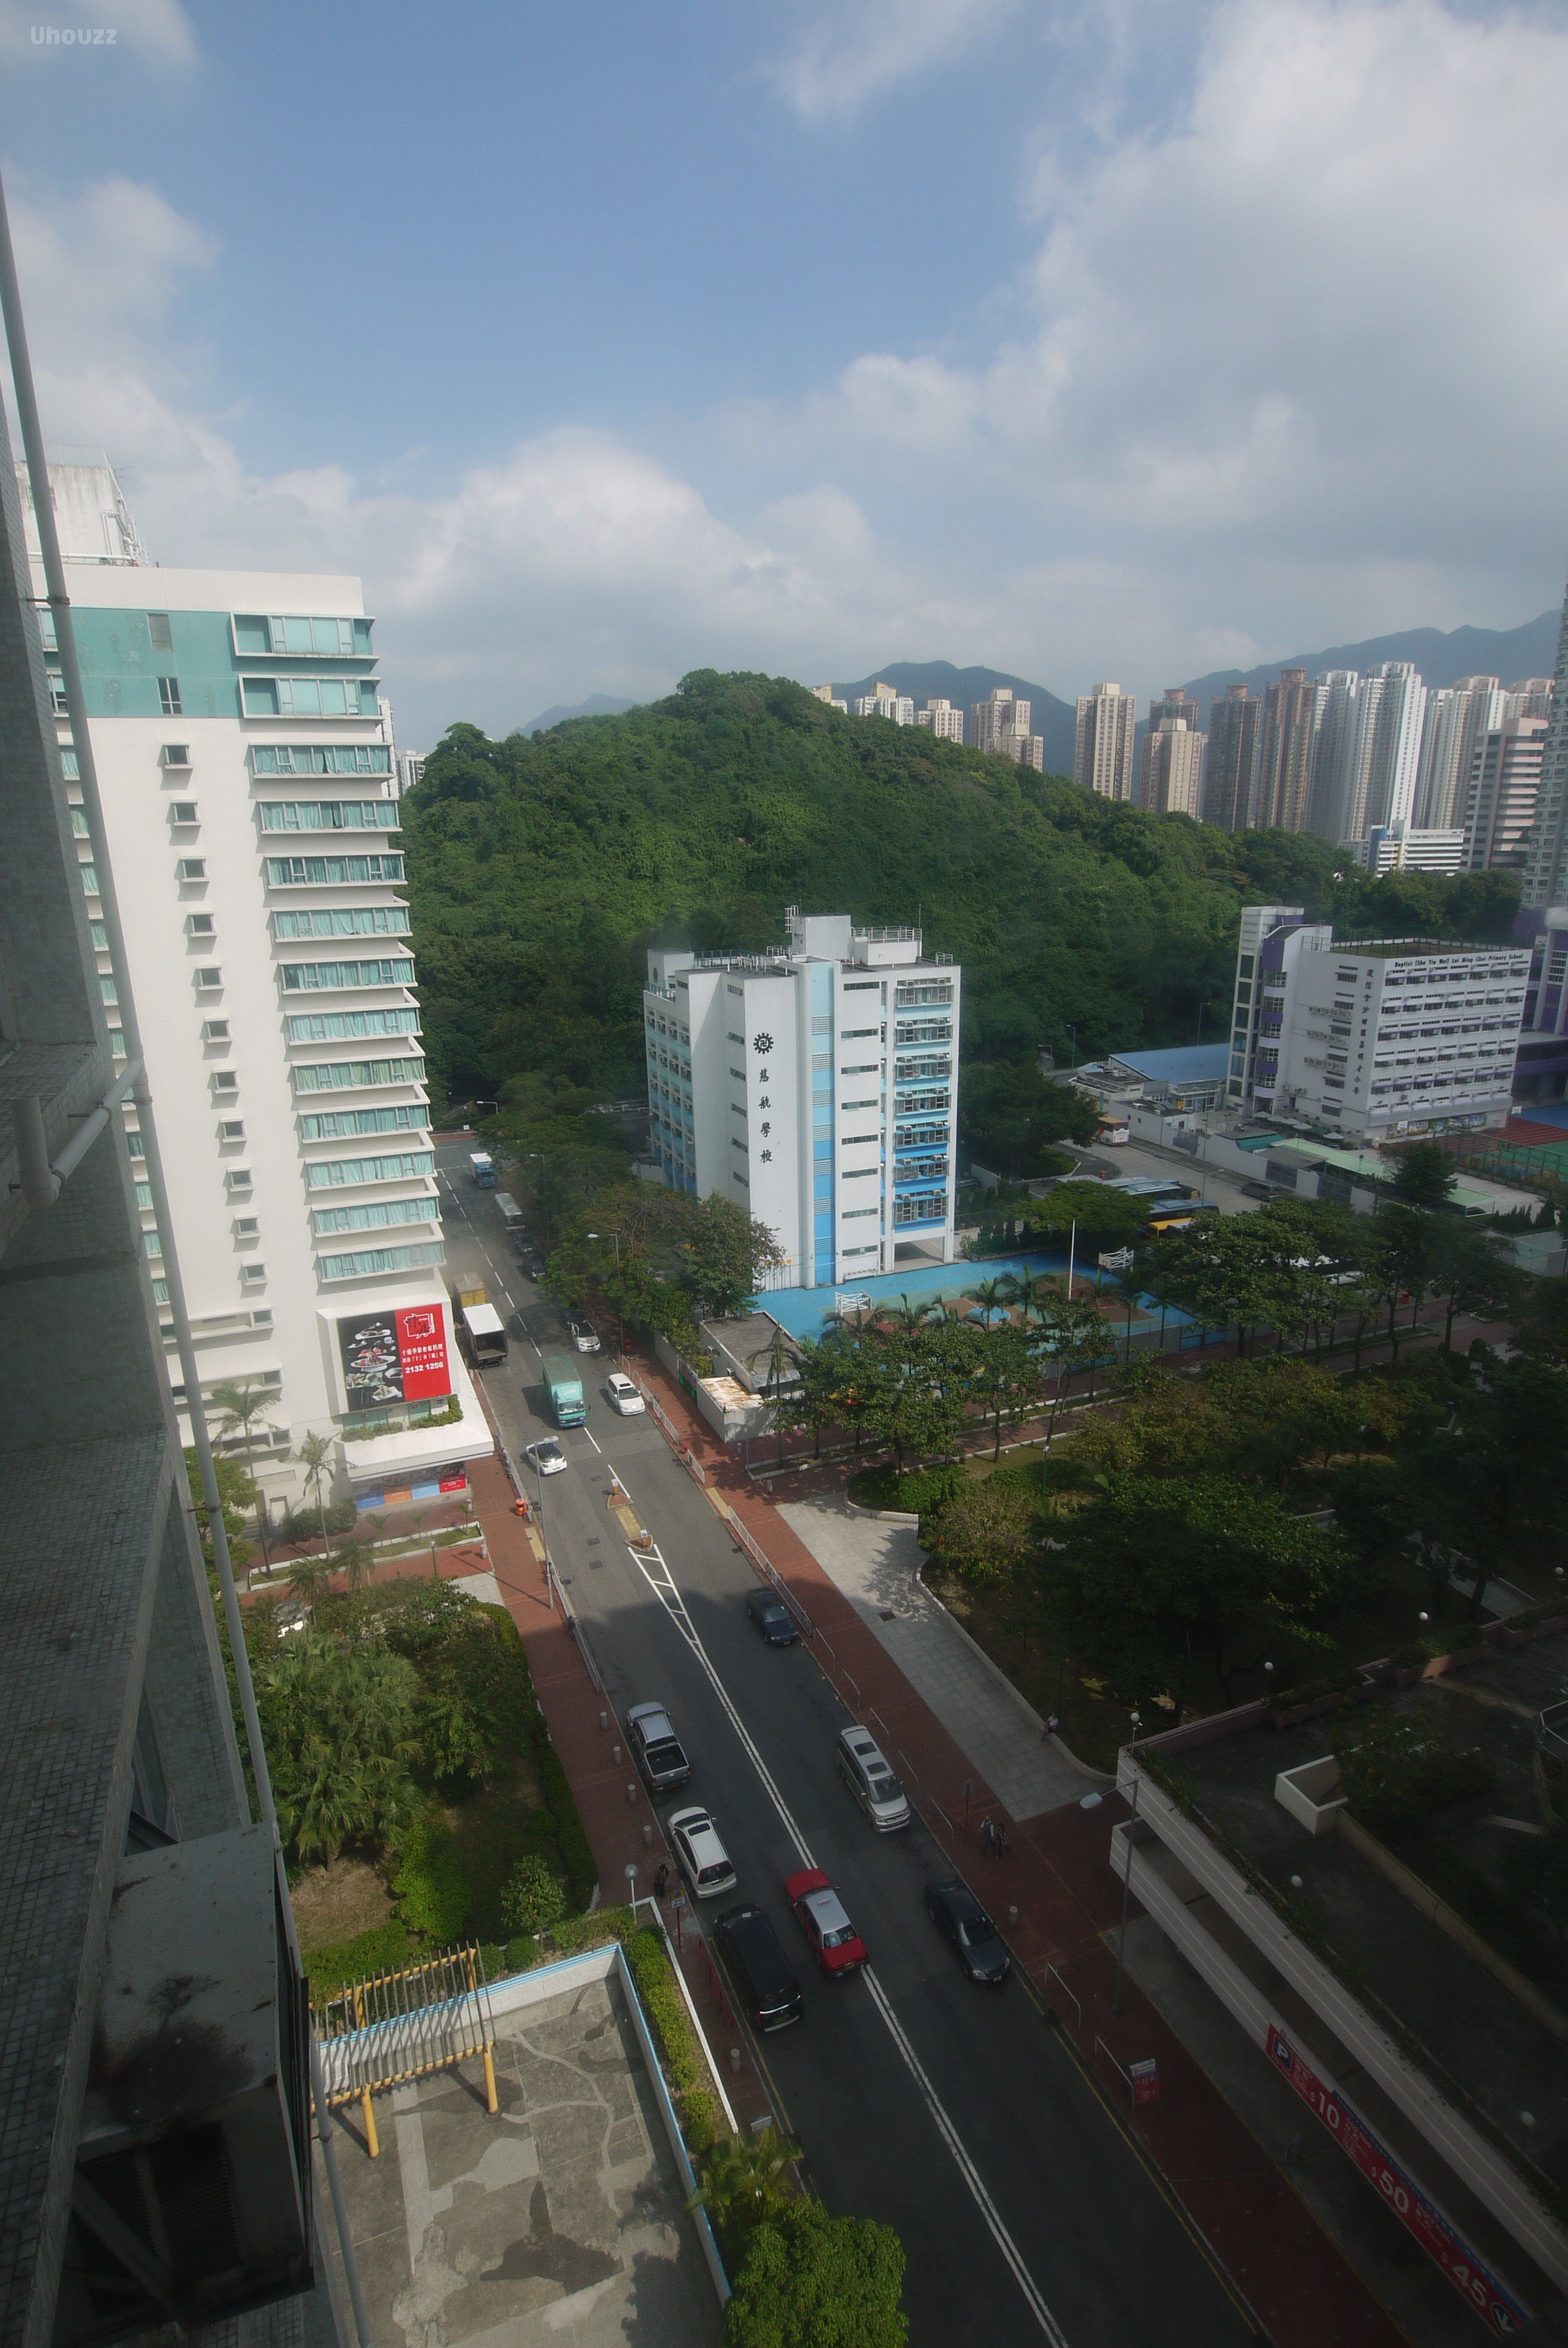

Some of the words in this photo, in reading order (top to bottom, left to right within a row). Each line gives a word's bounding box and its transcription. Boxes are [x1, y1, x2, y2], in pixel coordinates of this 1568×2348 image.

[758, 1067, 773, 1163] 慈航學校
[405, 1364, 424, 1374] 2132
[425, 1361, 444, 1370] 1256
[1278, 2042, 1289, 2059] P
